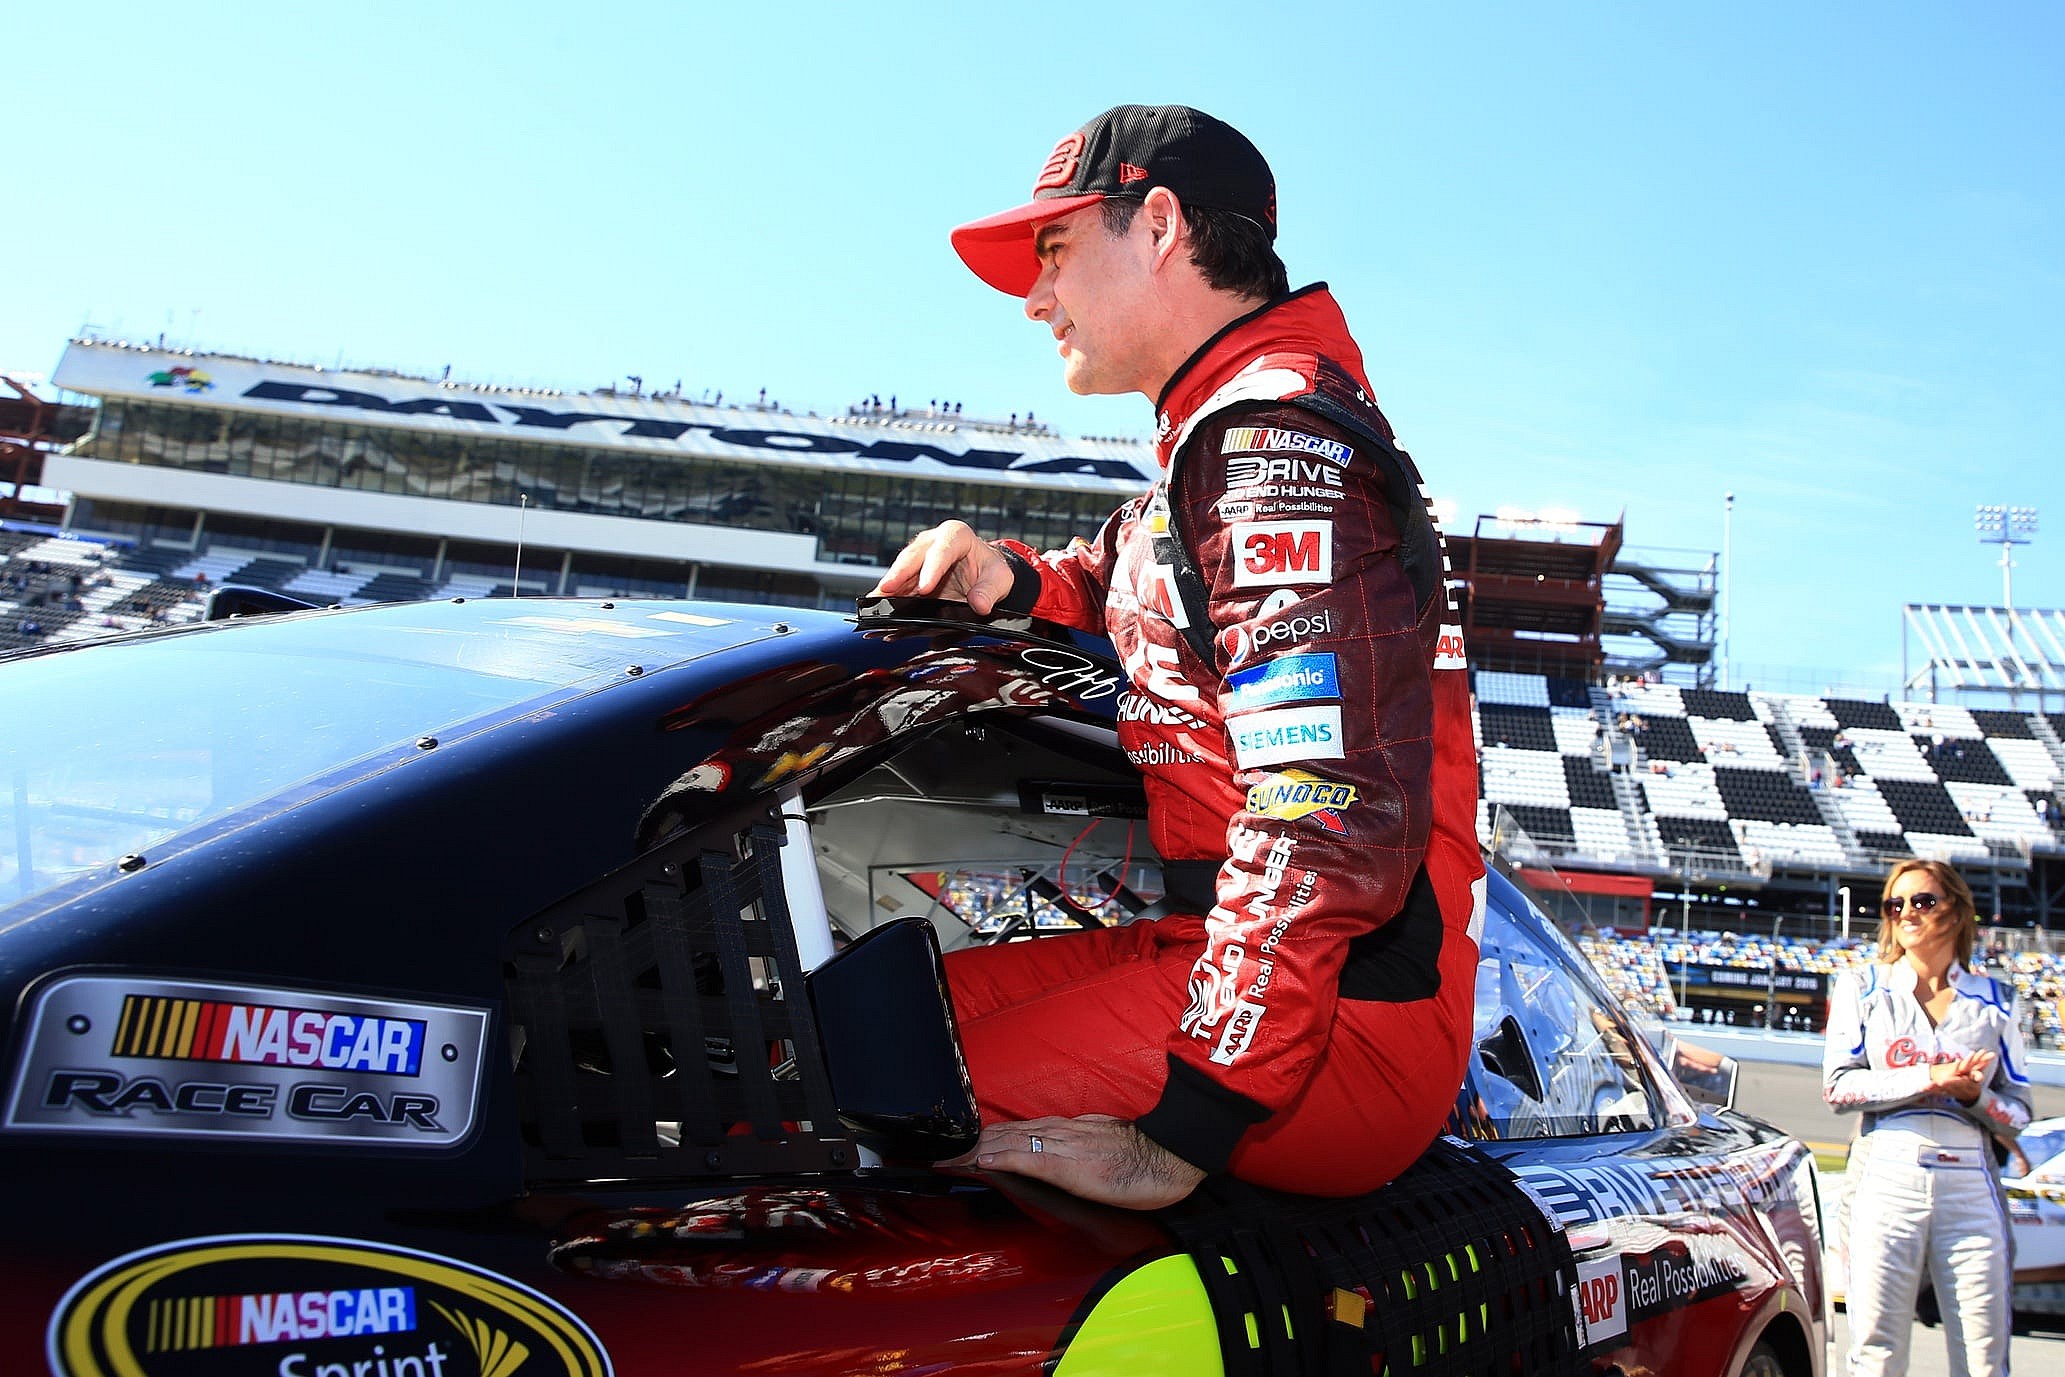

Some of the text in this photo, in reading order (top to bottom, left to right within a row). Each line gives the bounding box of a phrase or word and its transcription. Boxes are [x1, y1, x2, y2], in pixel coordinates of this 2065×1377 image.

[241, 380, 1150, 482] DAYTONA
[1226, 456, 1343, 488] DRIVE
[1281, 485, 1346, 500] HUNGER
[1255, 502, 1276, 514] Real
[1279, 500, 1334, 513] Possibilities
[1244, 531, 1320, 574] 3M
[1250, 608, 1332, 652] pepsi
[1239, 723, 1333, 752] SIEMENS
[1248, 782, 1351, 813] SUNOCO
[1247, 957, 1275, 998] Real
[221, 1005, 413, 1073] NASCAR
[45, 1071, 450, 1134] RACE CAR
[1630, 1269, 1662, 1310] Real
[1662, 1249, 1749, 1299] Possibilities
[238, 1288, 407, 1344] NASCAR
[278, 1342, 449, 1377] Sprint
